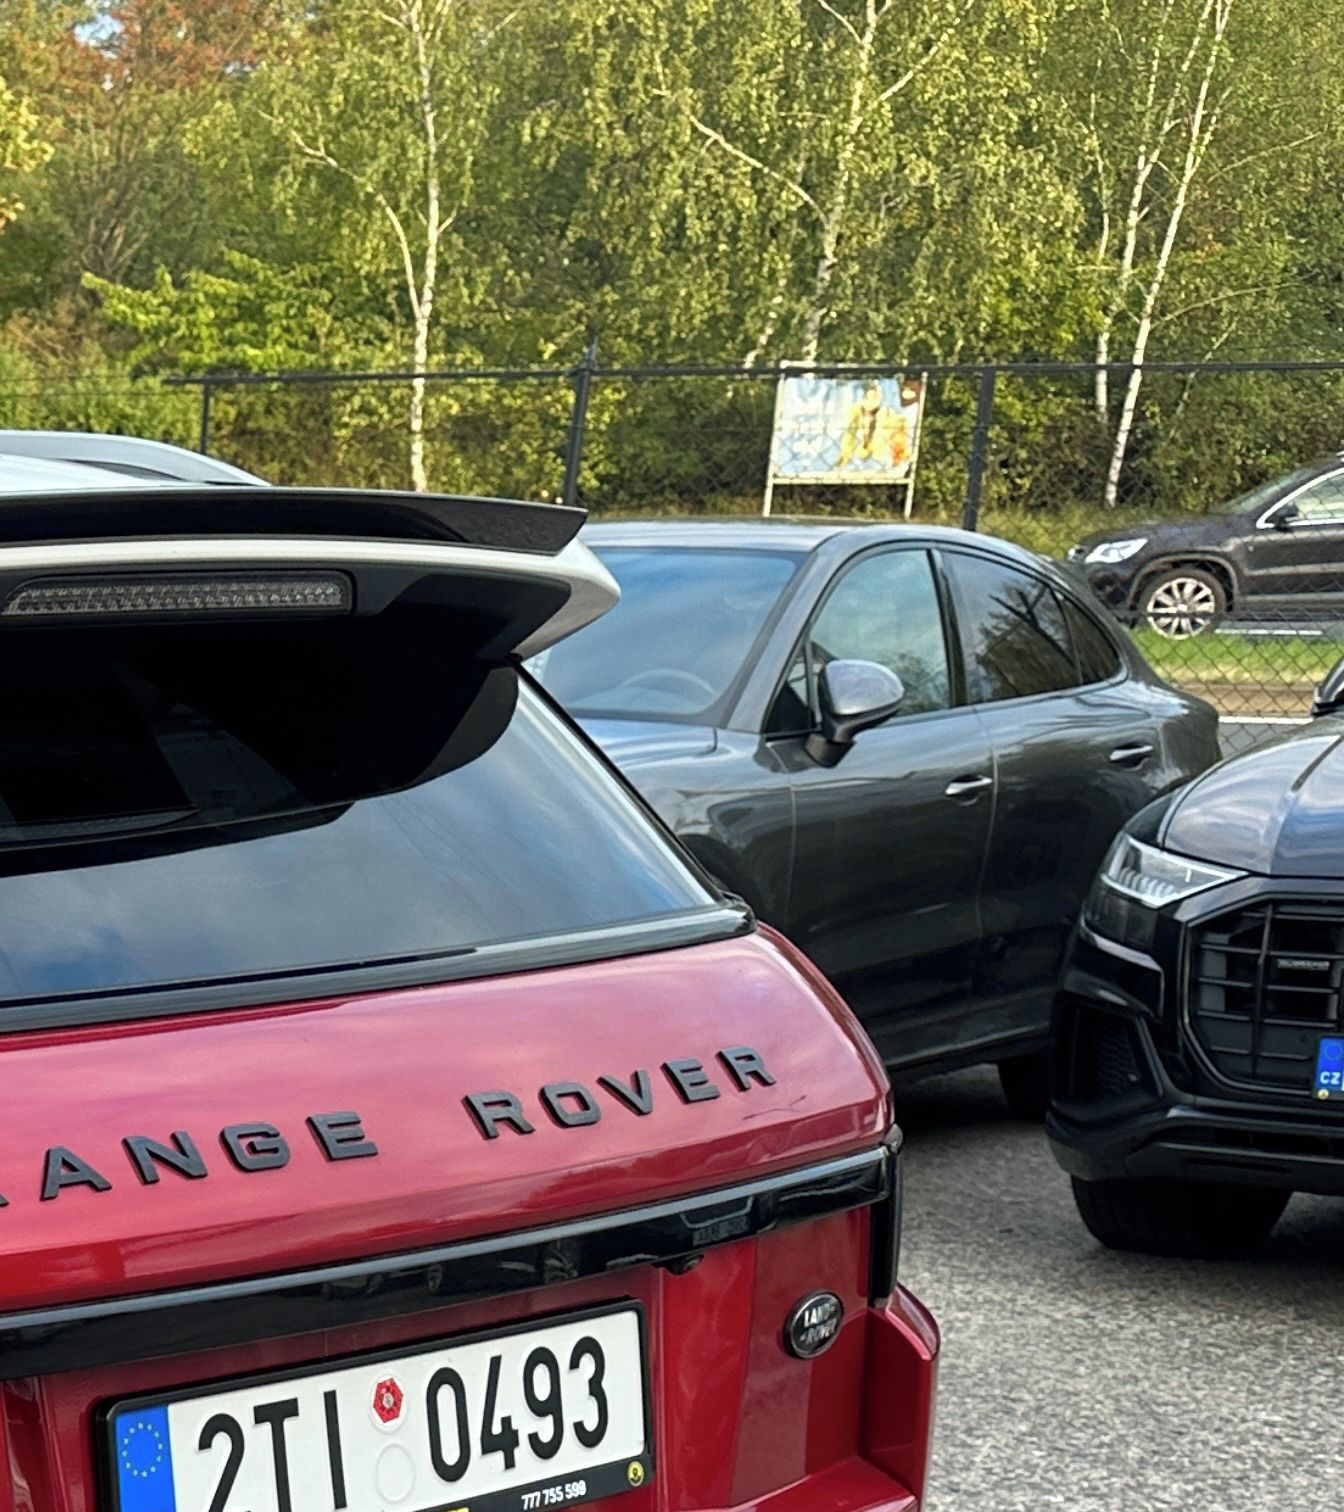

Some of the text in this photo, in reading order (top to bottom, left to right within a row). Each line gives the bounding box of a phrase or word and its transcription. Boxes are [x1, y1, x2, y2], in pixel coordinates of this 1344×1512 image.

[463, 1046, 777, 1140] ROVER
[1319, 1071, 1341, 1085] CZ
[426, 1335, 609, 1482] 0493
[521, 1491, 541, 1510] 777
